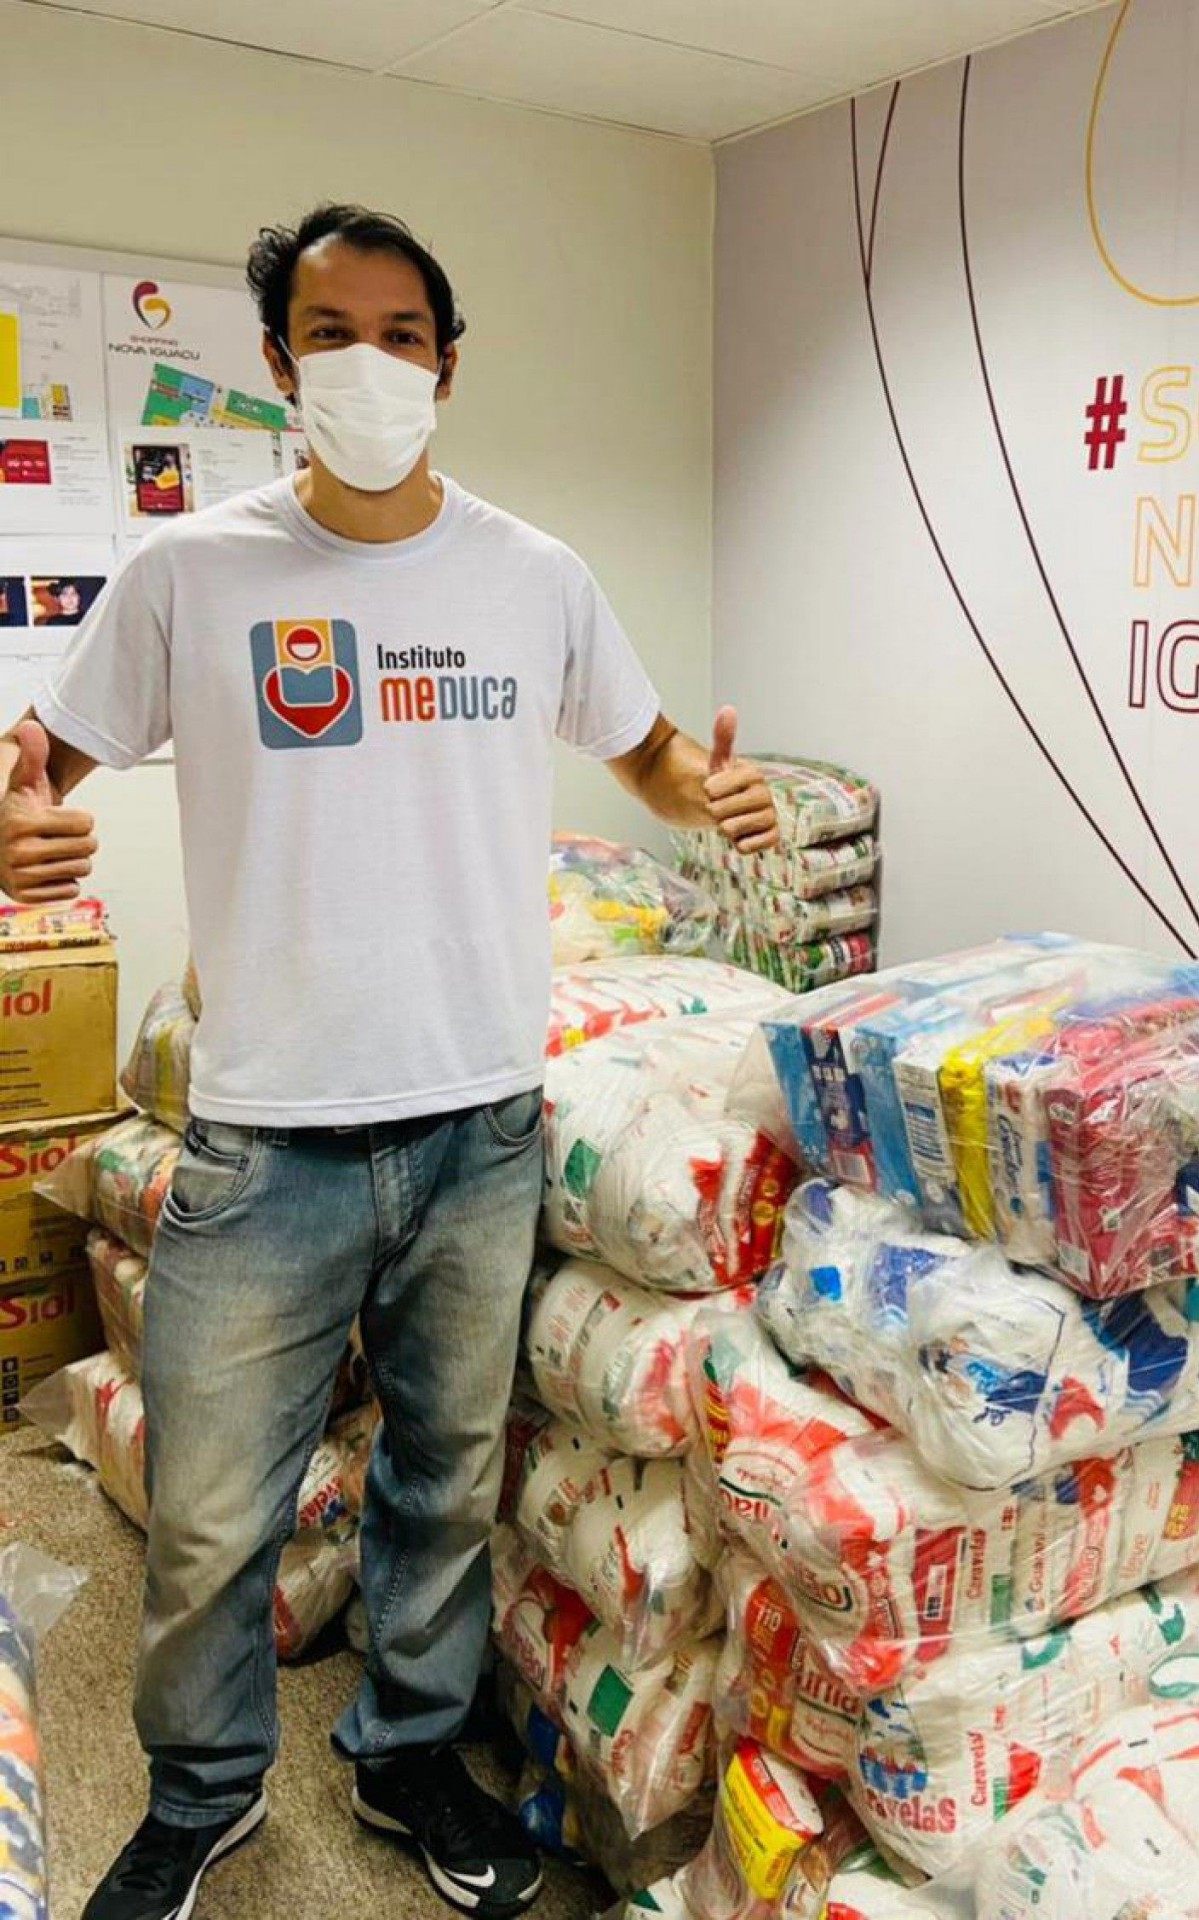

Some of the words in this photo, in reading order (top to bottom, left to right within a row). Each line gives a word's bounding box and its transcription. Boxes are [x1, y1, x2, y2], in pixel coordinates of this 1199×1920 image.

[109, 343, 148, 355] NOVA
[376, 643, 466, 670] Instituto
[0, 1292, 76, 1331] Siol
